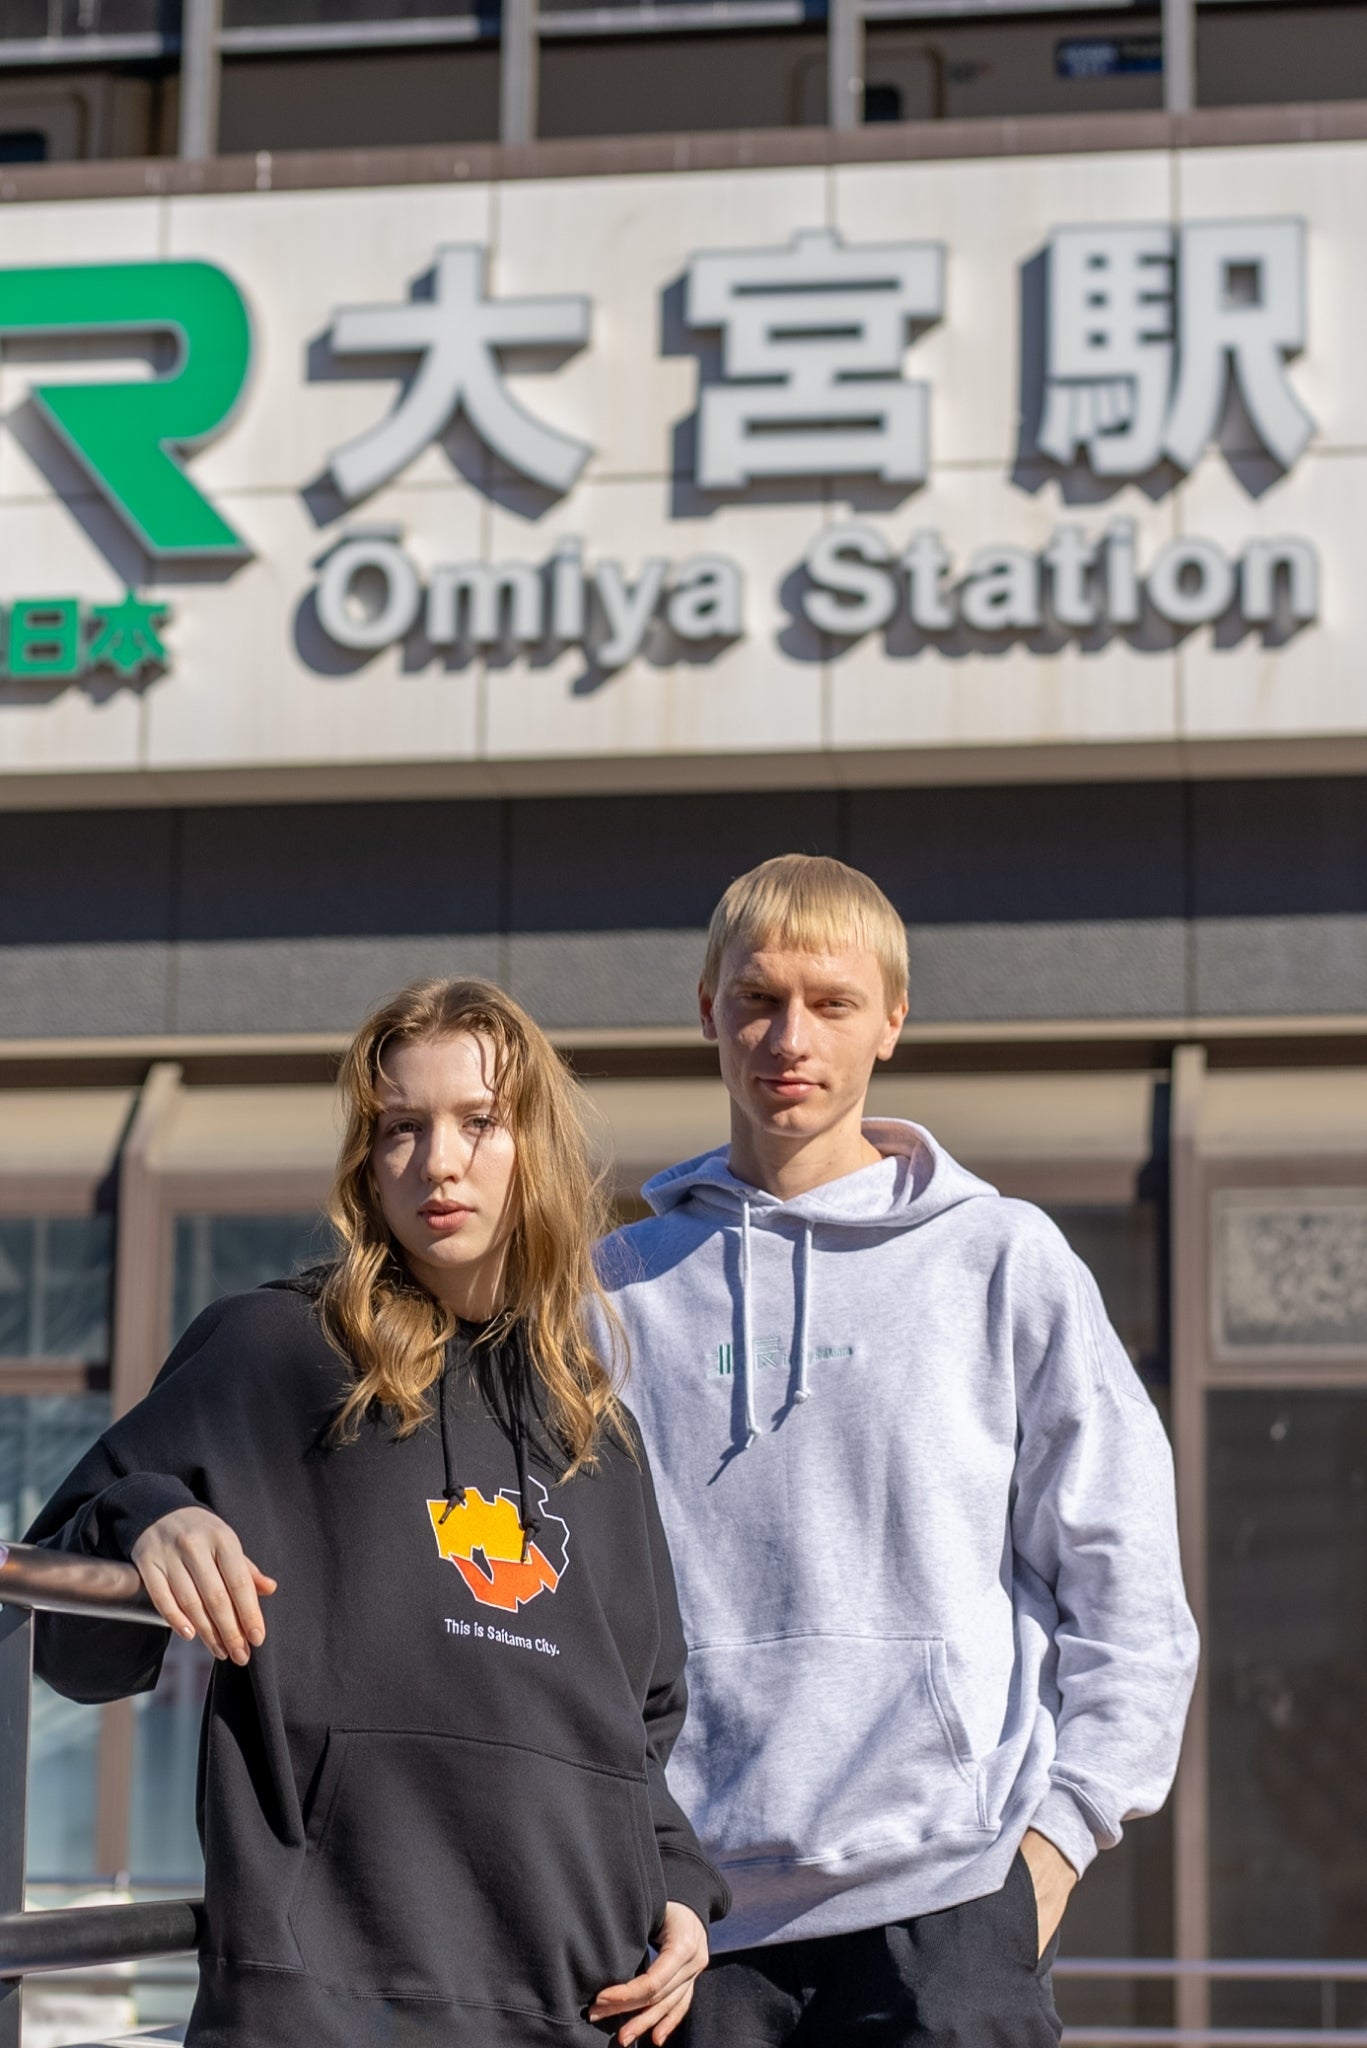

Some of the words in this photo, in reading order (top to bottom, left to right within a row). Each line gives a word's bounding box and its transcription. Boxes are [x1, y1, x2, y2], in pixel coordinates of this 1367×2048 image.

[330, 216, 1317, 501] 大宮駅
[315, 522, 743, 668] Ōmiya
[801, 516, 1320, 636] Station
[444, 1618, 471, 1636] This
[474, 1621, 484, 1638] is
[487, 1625, 532, 1650] Saitama
[534, 1638, 560, 1657] City.
